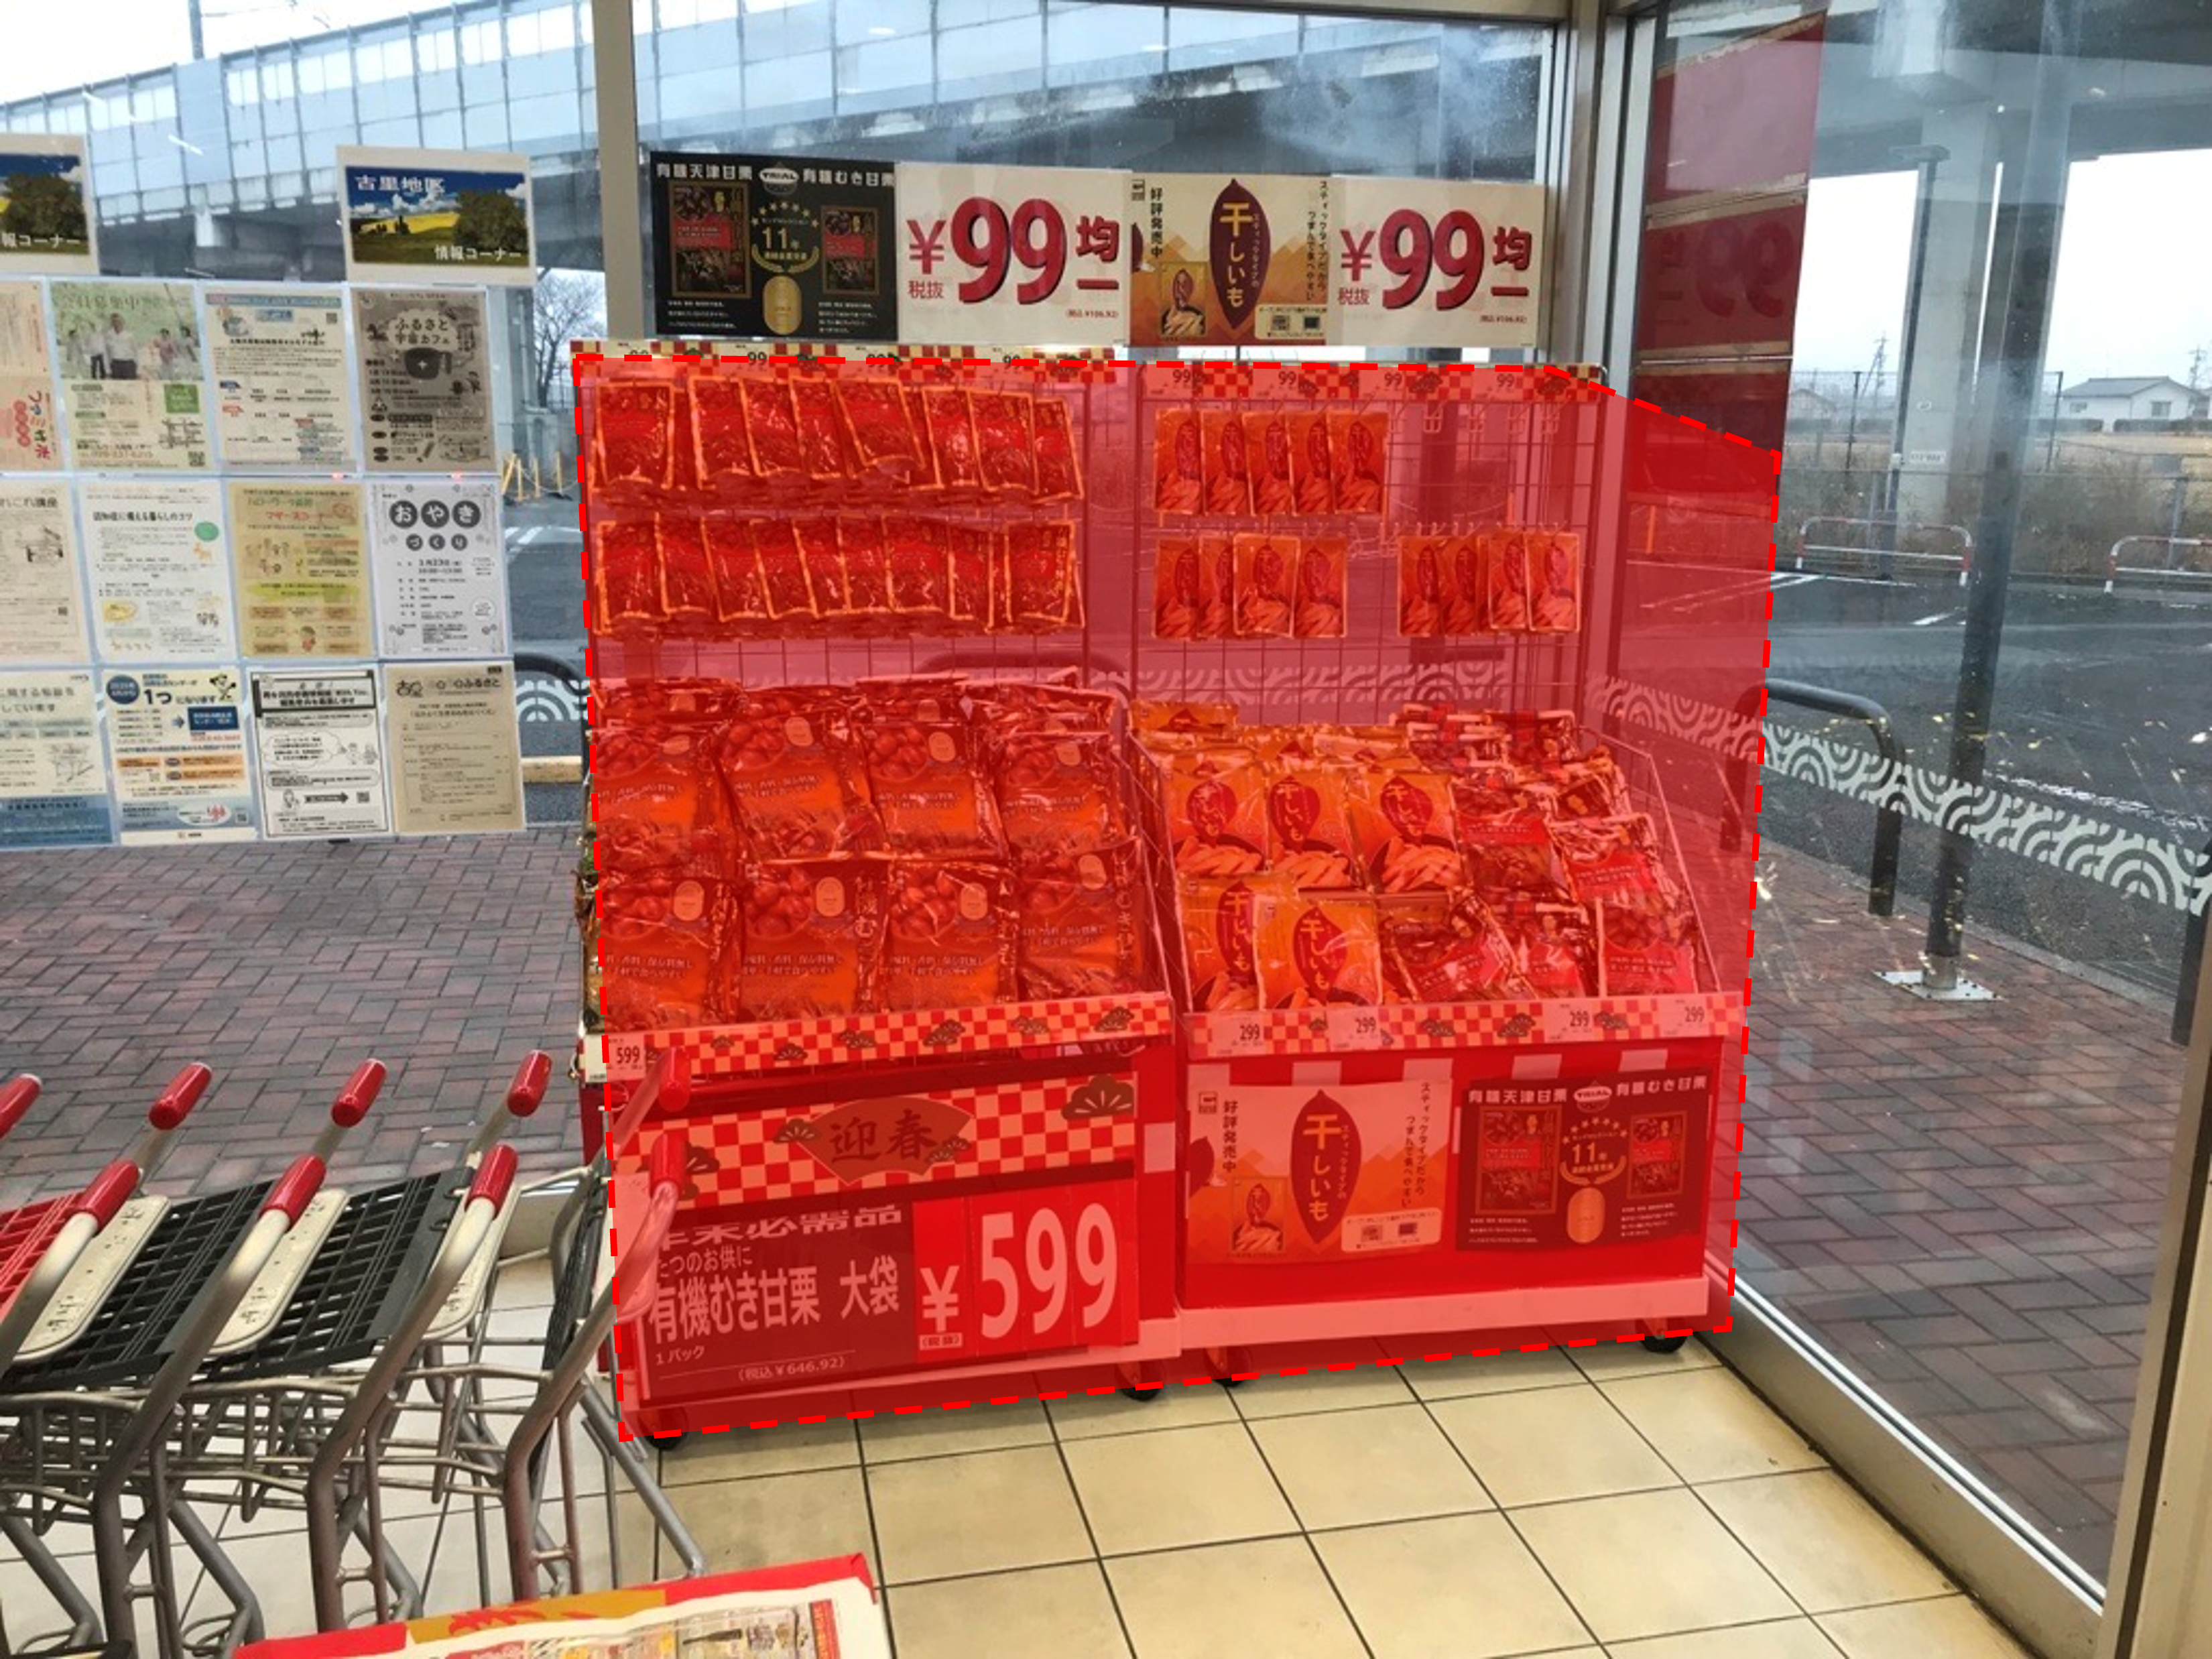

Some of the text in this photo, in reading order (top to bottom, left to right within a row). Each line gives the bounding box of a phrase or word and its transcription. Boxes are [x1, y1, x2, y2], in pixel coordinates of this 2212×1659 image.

[657, 163, 753, 180] 有機天津甘栗
[803, 168, 894, 186] 有機むき甘栗
[1150, 188, 1162, 258] 好評発売中
[435, 245, 521, 261] 情報コーナー
[1220, 203, 1253, 308] 干しいも
[908, 280, 944, 298] 税抜
[1339, 288, 1369, 304] 税抜
[395, 319, 448, 331] ふるさと
[1174, 370, 1191, 383] 99
[1279, 371, 1296, 385] 99
[1384, 373, 1402, 386] 99
[1497, 374, 1514, 387] 99
[393, 503, 477, 526] おやき
[1224, 892, 1252, 971] 干しいも
[1300, 920, 1334, 990] 干しいも
[1570, 1011, 1590, 1028] 299
[1684, 1006, 1705, 1023] 299
[1239, 1024, 1261, 1041] 299
[1355, 1017, 1377, 1034] 299
[617, 1046, 640, 1064] 599
[1616, 1076, 1707, 1096] 有機むき甘栗
[829, 1109, 937, 1163] 迎春
[1223, 1101, 1238, 1173] 好評発売中
[1303, 1114, 1341, 1221] 干しいも
[650, 1255, 900, 1345] 有機むき甘栗 大袋
